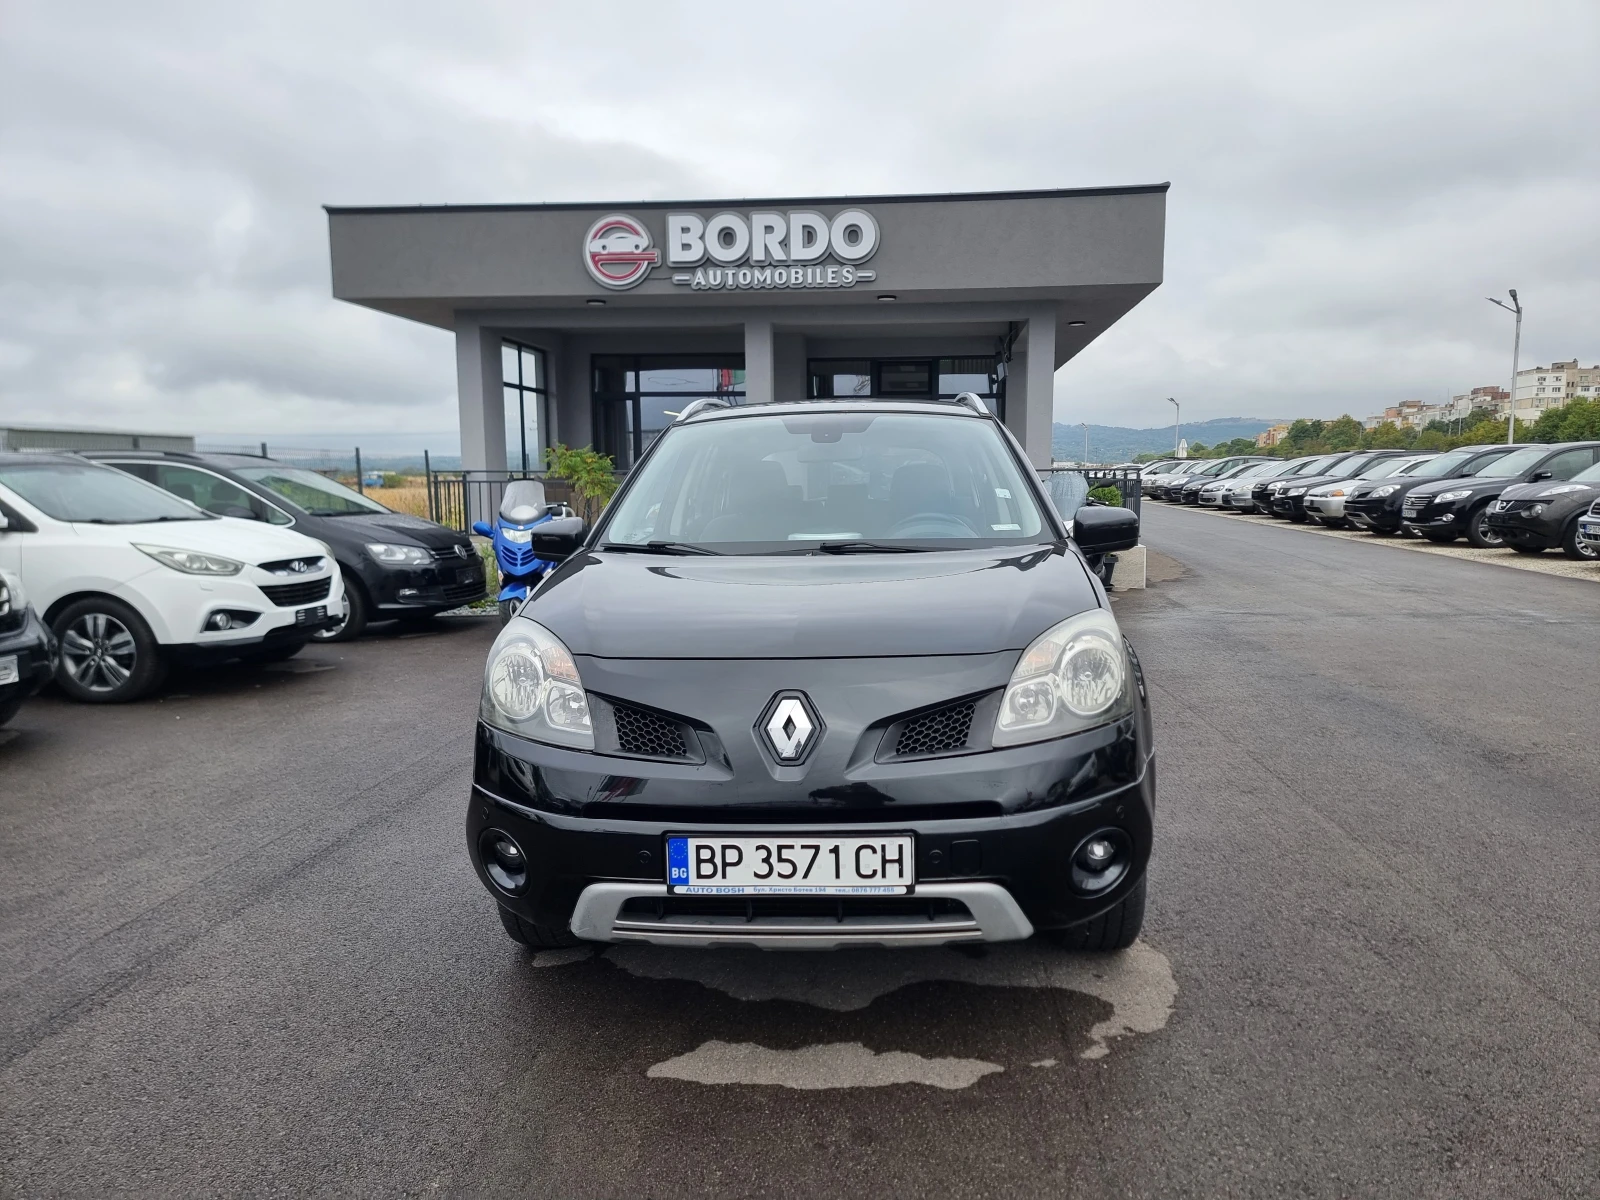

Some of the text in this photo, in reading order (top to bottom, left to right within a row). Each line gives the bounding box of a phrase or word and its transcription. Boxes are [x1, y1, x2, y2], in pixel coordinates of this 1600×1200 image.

[668, 211, 876, 263] BORDO
[693, 267, 854, 287] AUTOMOBILES
[671, 868, 688, 879] BG
[695, 843, 904, 880] BP 3571 CH
